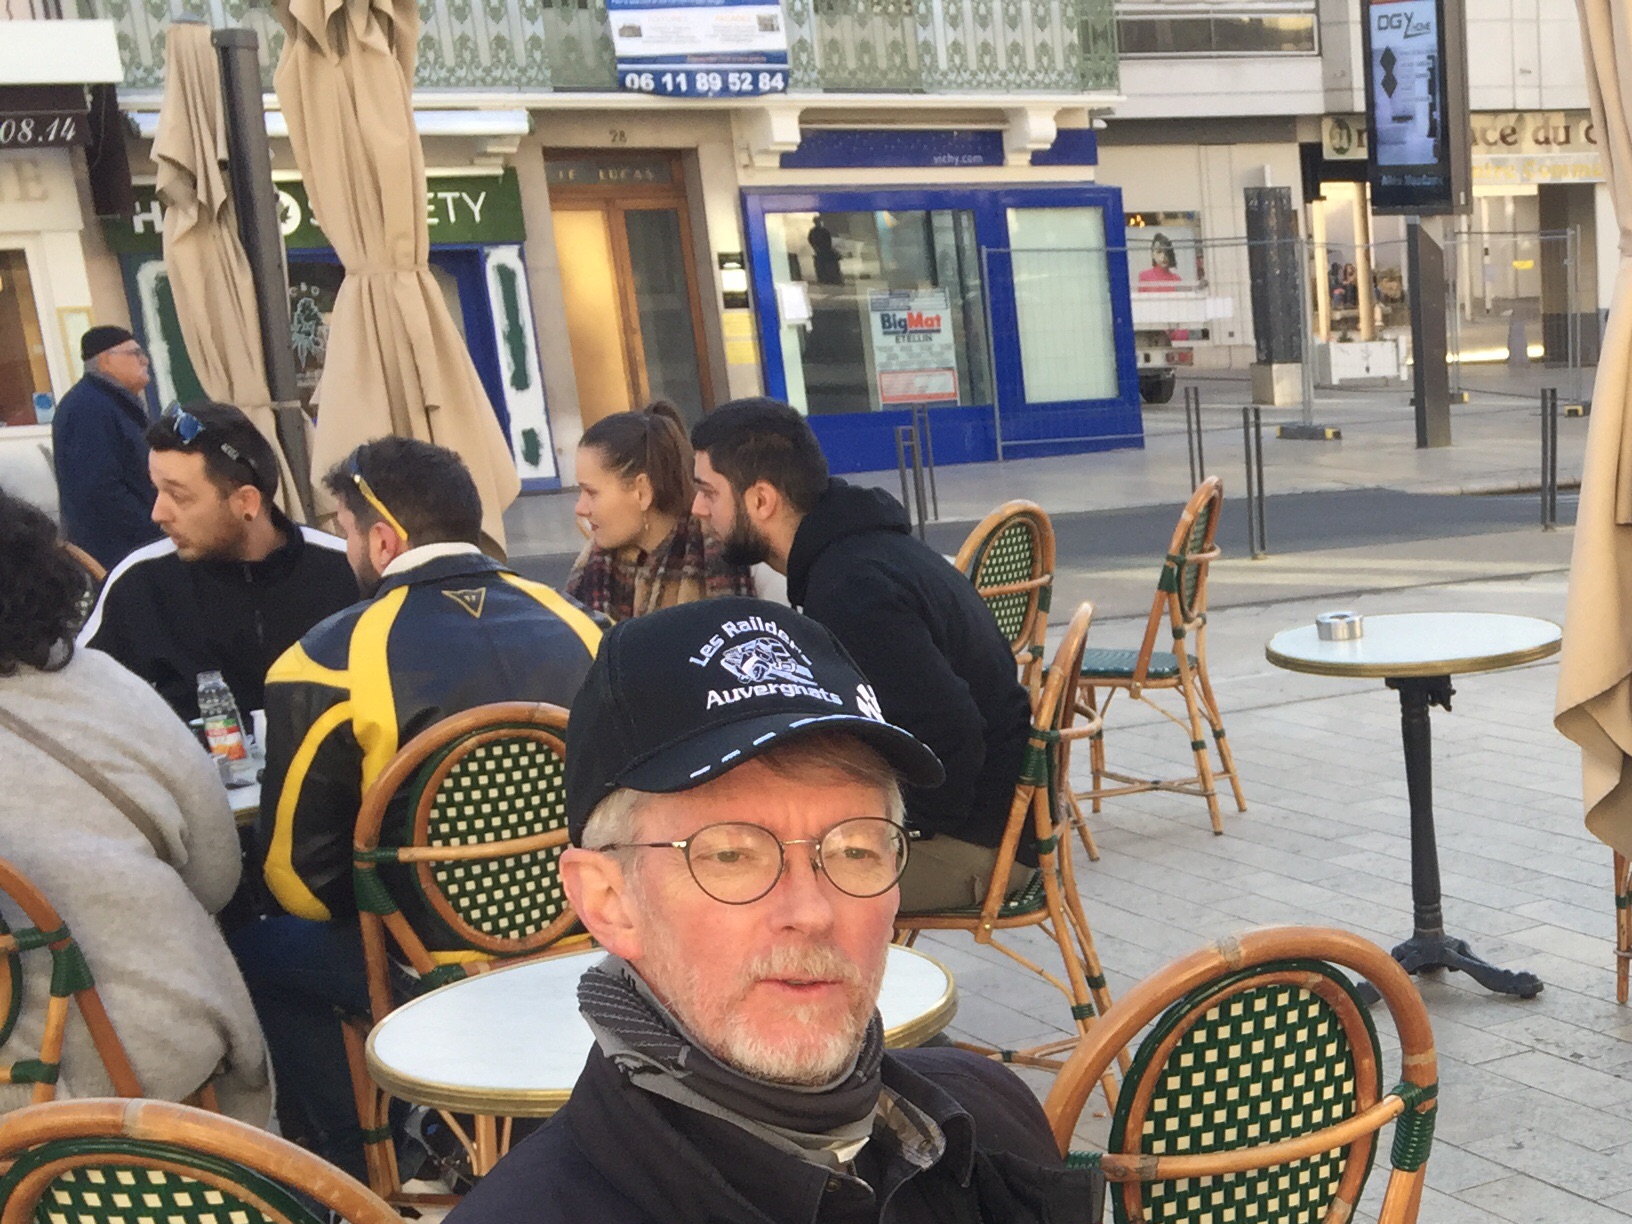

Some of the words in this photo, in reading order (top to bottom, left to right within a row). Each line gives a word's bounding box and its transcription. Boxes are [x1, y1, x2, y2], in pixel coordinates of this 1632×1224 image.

[625, 72, 654, 91] 06
[661, 72, 687, 92] 11
[695, 72, 722, 91] 89
[728, 72, 753, 91] 52
[758, 72, 784, 91] 84
[1532, 116, 1572, 146] du
[289, 282, 320, 298] CBD
[881, 311, 942, 334] BigMat
[689, 624, 725, 668] Les
[706, 673, 843, 710] Auvergnats
